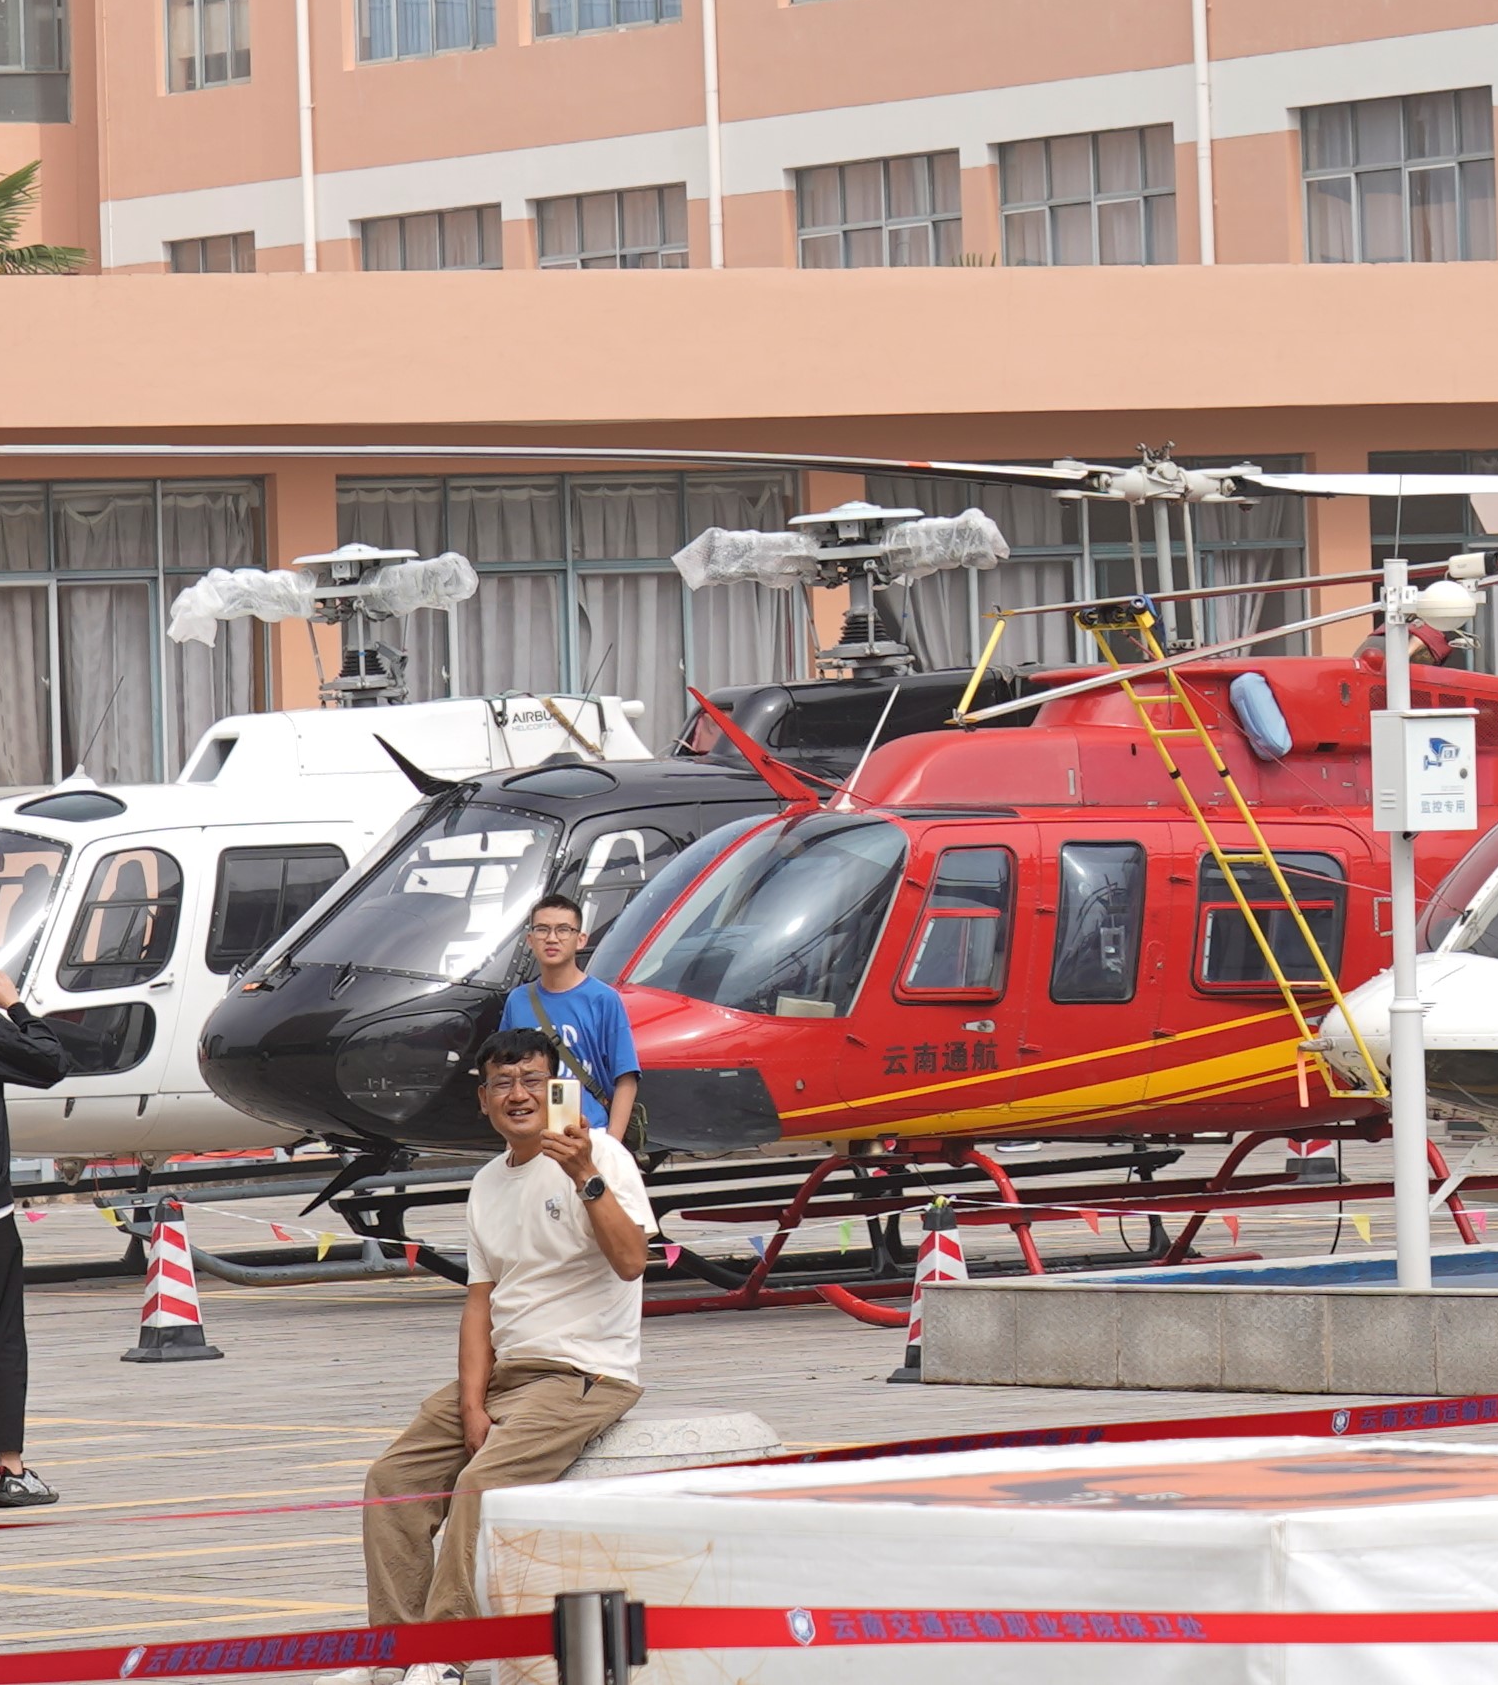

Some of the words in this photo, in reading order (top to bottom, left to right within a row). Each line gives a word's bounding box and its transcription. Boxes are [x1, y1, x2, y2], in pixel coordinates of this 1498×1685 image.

[512, 710, 553, 724] AIRBU
[1421, 800, 1465, 813] 监控专用
[883, 1039, 999, 1075] 云南通航
[830, 1610, 1207, 1640] 云南交通运输职业学院保卫处
[147, 1629, 397, 1674] 云南交通运输职业学院保卫处
